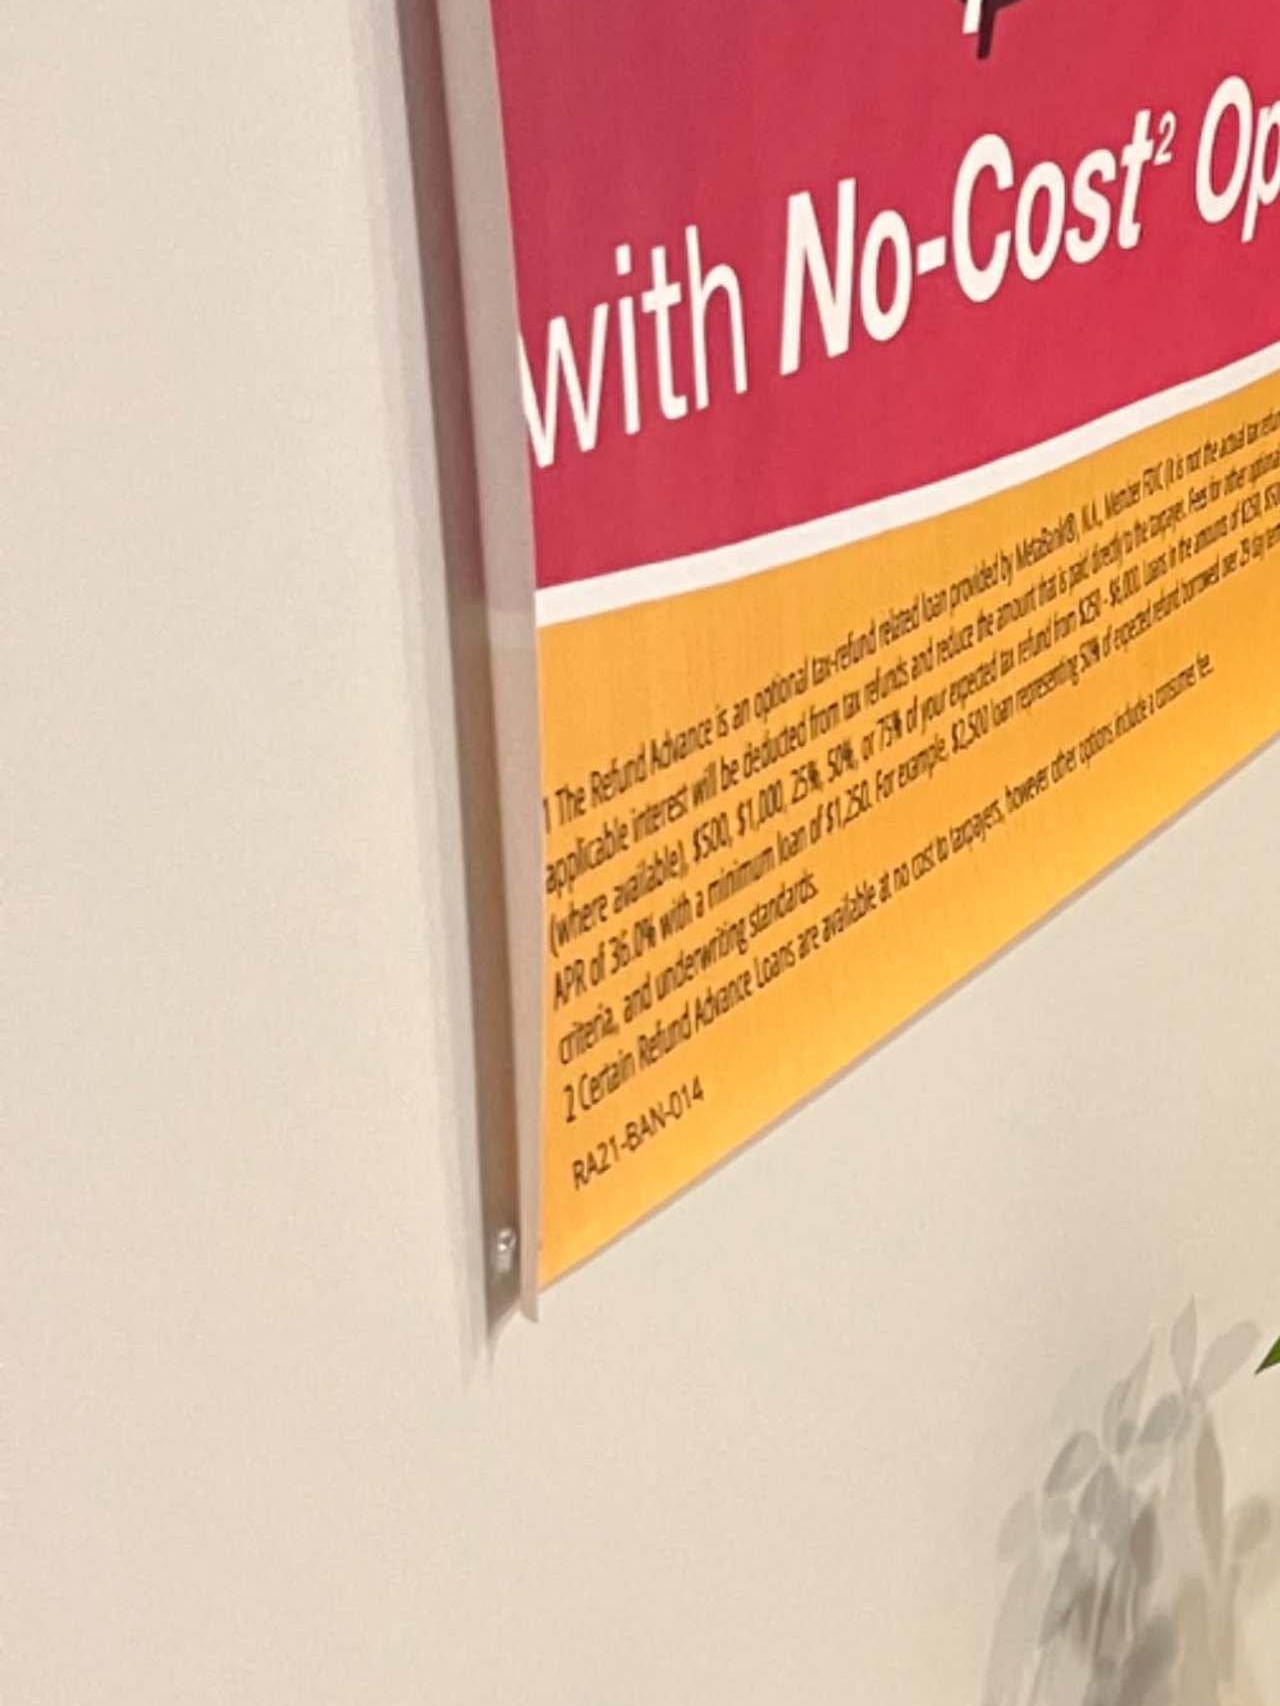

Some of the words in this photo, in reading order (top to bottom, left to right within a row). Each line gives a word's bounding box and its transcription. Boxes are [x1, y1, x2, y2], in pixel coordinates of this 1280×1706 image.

[517, 225, 747, 468] with
[543, 796, 551, 835] 1
[555, 783, 586, 827] The
[590, 741, 647, 809] Refund
[650, 716, 712, 777] Advance
[715, 703, 729, 740] is
[732, 697, 750, 732] an
[754, 656, 809, 725] optional
[812, 618, 877, 688] tax-refund
[545, 815, 629, 901] applicable
[630, 782, 688, 844] interest
[691, 760, 717, 810] will
[720, 754, 739, 793] be
[743, 710, 807, 780] deducted
[809, 700, 840, 742] from
[549, 892, 608, 960] (where
[553, 958, 587, 1012] APR
[589, 940, 606, 988] of
[608, 912, 657, 976] 36.0%
[658, 890, 693, 942] with
[695, 889, 705, 920] a
[707, 845, 775, 911] minimum
[776, 824, 807, 867] loan
[809, 802, 823, 846] of
[563, 1082, 576, 1125] 2
[578, 1048, 635, 1112] Certain
[637, 999, 691, 1071] Refund
[695, 969, 752, 1034] Advance
[754, 939, 796, 990] Loans
[797, 923, 820, 961] are
[822, 879, 878, 944] available
[878, 870, 891, 905] at
[893, 861, 910, 893] no
[911, 840, 935, 882] cost
[623, 970, 652, 1025] and
[655, 915, 749, 1002] underwriting
[572, 1074, 704, 1191] RA21-BAN-014
